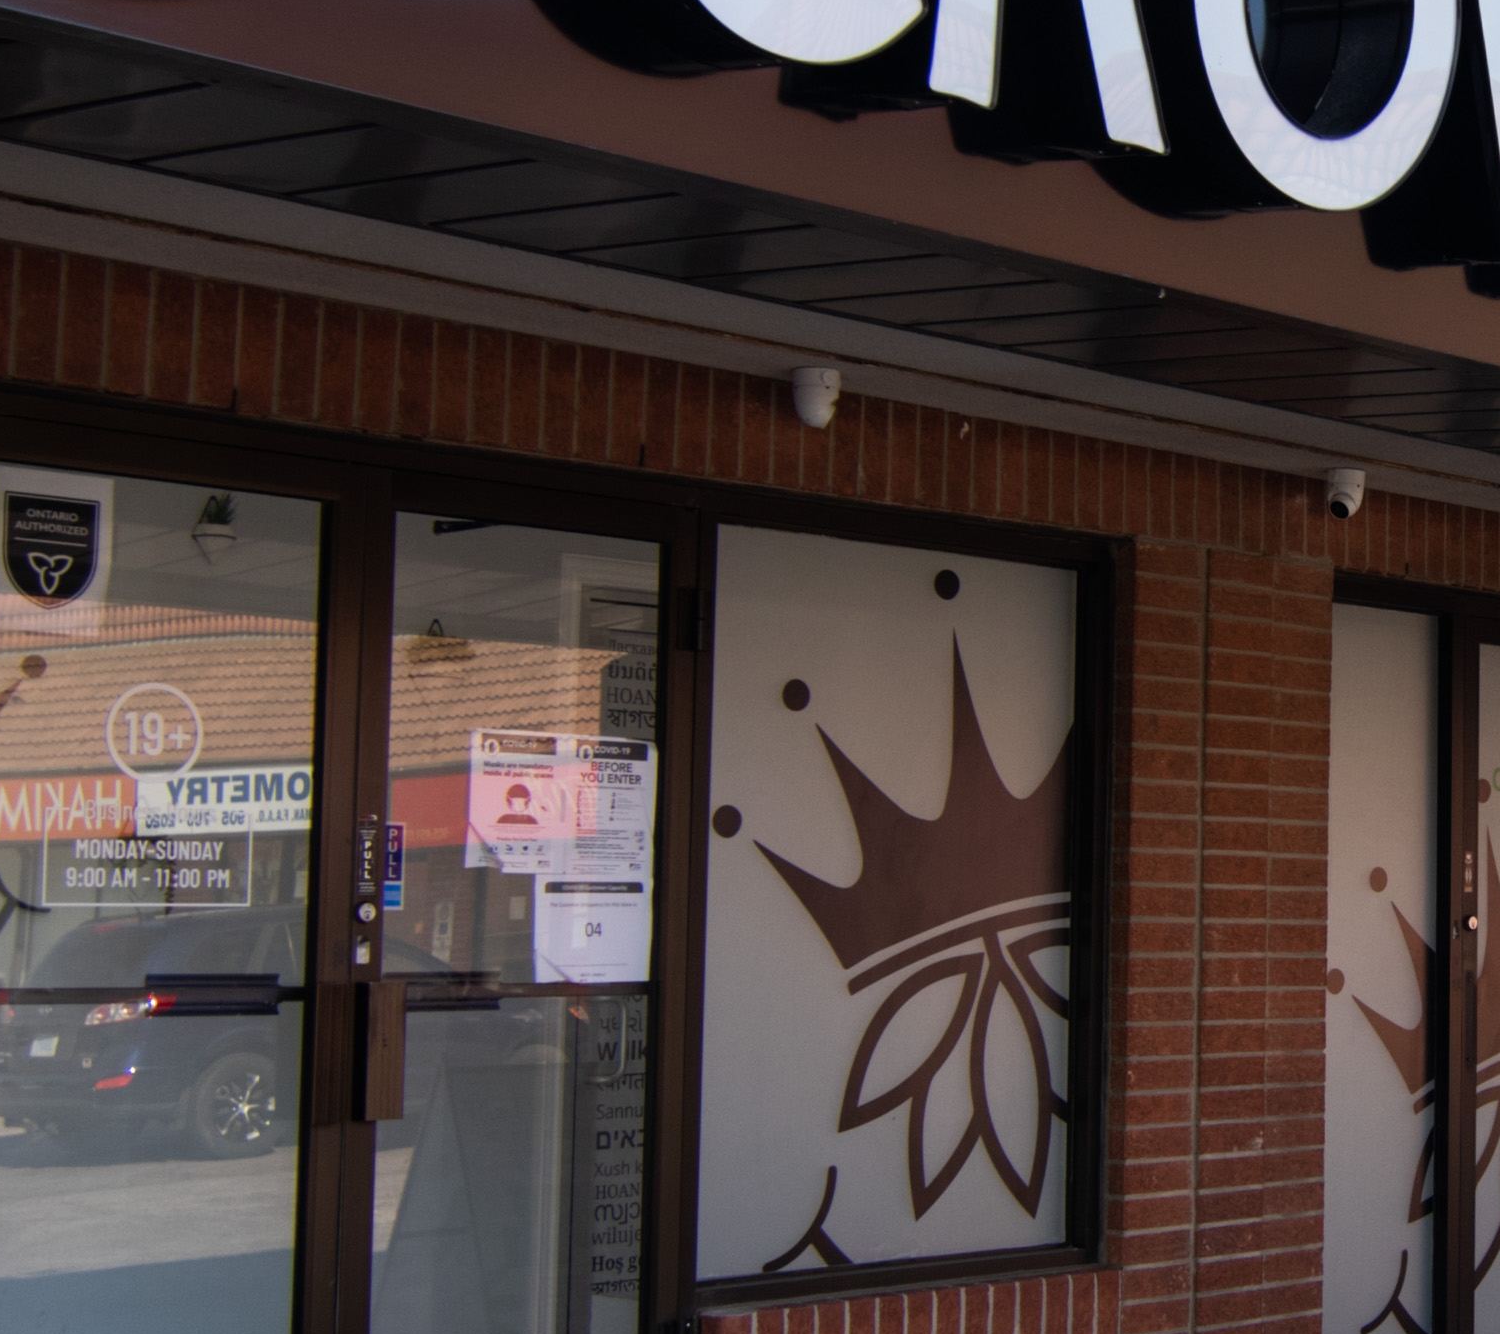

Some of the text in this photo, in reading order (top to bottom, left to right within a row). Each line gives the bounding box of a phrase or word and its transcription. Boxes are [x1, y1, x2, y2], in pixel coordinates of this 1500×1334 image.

[26, 508, 79, 523] ONTARIO
[14, 520, 89, 537] AUTHORIZED
[124, 712, 192, 755] 19+
[594, 745, 632, 756] COVID-19
[591, 761, 633, 774] BEFORE
[581, 773, 642, 785] YOU ENTER
[75, 838, 224, 861] MONDAY-SUNDAY
[388, 828, 398, 878] PULL
[363, 841, 373, 879] PULL
[66, 868, 107, 887] 9:00
[111, 868, 137, 888] AM
[156, 868, 201, 888] 11:00
[207, 868, 230, 888] PM
[585, 922, 602, 937] 04
[597, 1039, 647, 1061] Wllk
